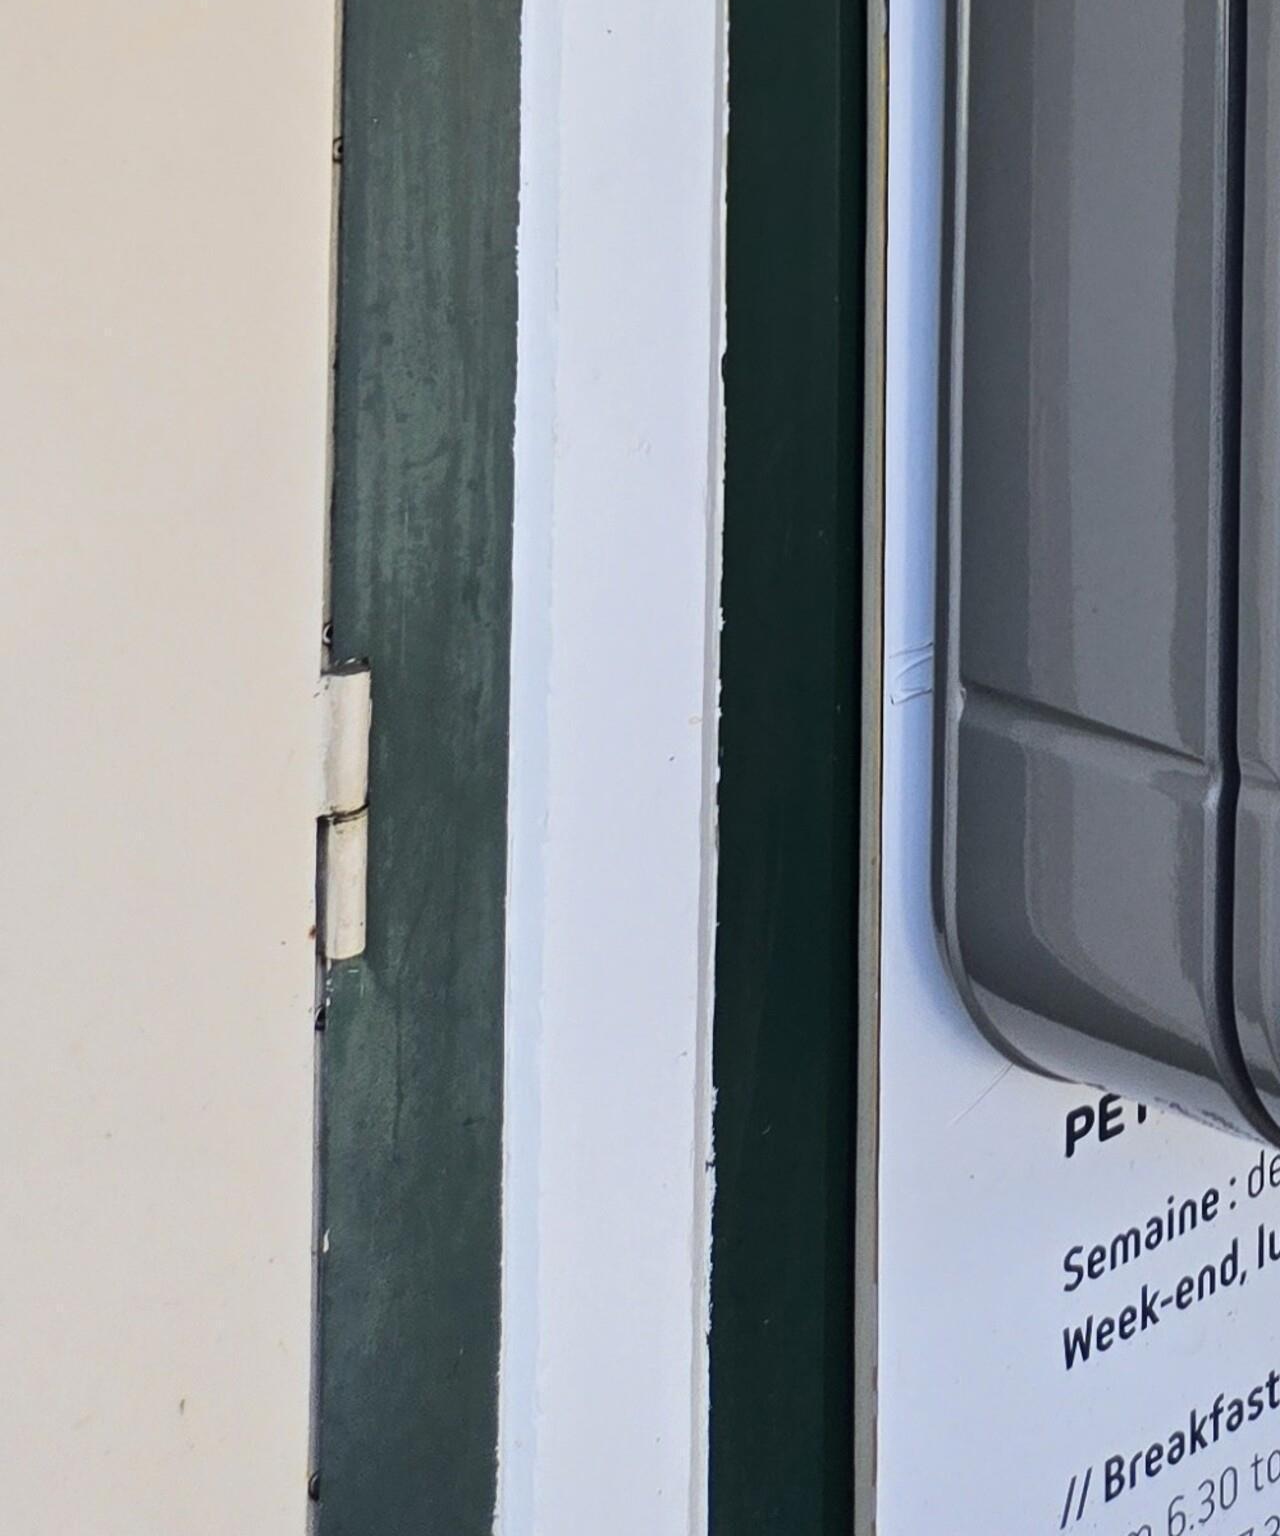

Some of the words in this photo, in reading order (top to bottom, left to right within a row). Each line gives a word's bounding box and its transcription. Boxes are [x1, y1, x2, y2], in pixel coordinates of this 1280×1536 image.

[1063, 1186, 1219, 1293] Semaine
[1063, 1237, 1246, 1371] Week-end,
[1104, 1369, 1280, 1504] Breakfast
[1168, 1466, 1239, 1536] 6.30
